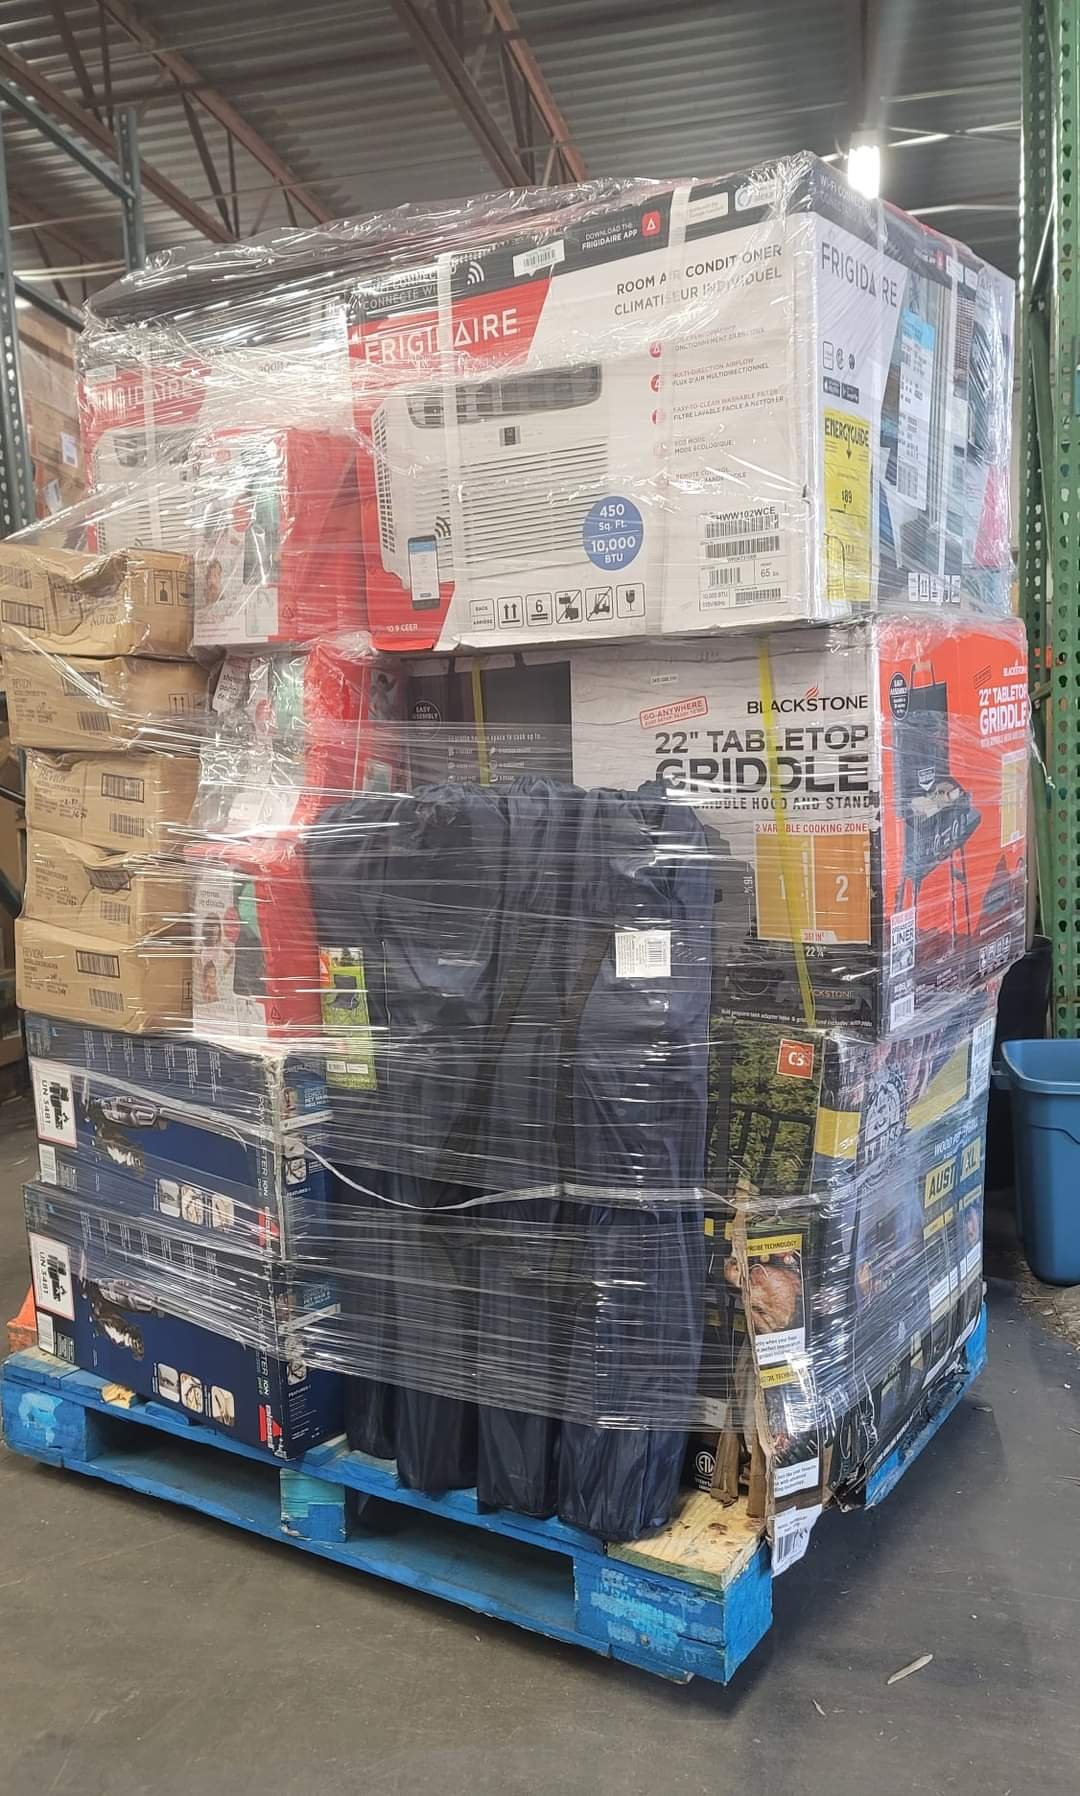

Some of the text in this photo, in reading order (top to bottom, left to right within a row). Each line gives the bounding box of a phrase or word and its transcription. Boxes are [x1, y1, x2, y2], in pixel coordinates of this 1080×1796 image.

[582, 229, 638, 250] FRIGIDAIRE APP
[585, 224, 622, 240] DOWNLOAD
[820, 241, 898, 308] FRIGIDARE
[616, 276, 656, 296] ROOM
[364, 308, 520, 367] FRIGIAIRE
[600, 503, 626, 518] 450
[598, 520, 628, 532] Sq. Ft.
[591, 536, 636, 554] 10,000
[605, 553, 624, 564] BTU
[535, 599, 544, 613] 6
[655, 731, 699, 754] 22"
[655, 755, 870, 794] GRIDDLE
[792, 796, 820, 810] AND
[825, 796, 871, 810] STAND
[755, 823, 761, 833] 2
[761, 823, 802, 833] VARBLE
[803, 823, 843, 833] COOKING
[835, 875, 849, 902] 2
